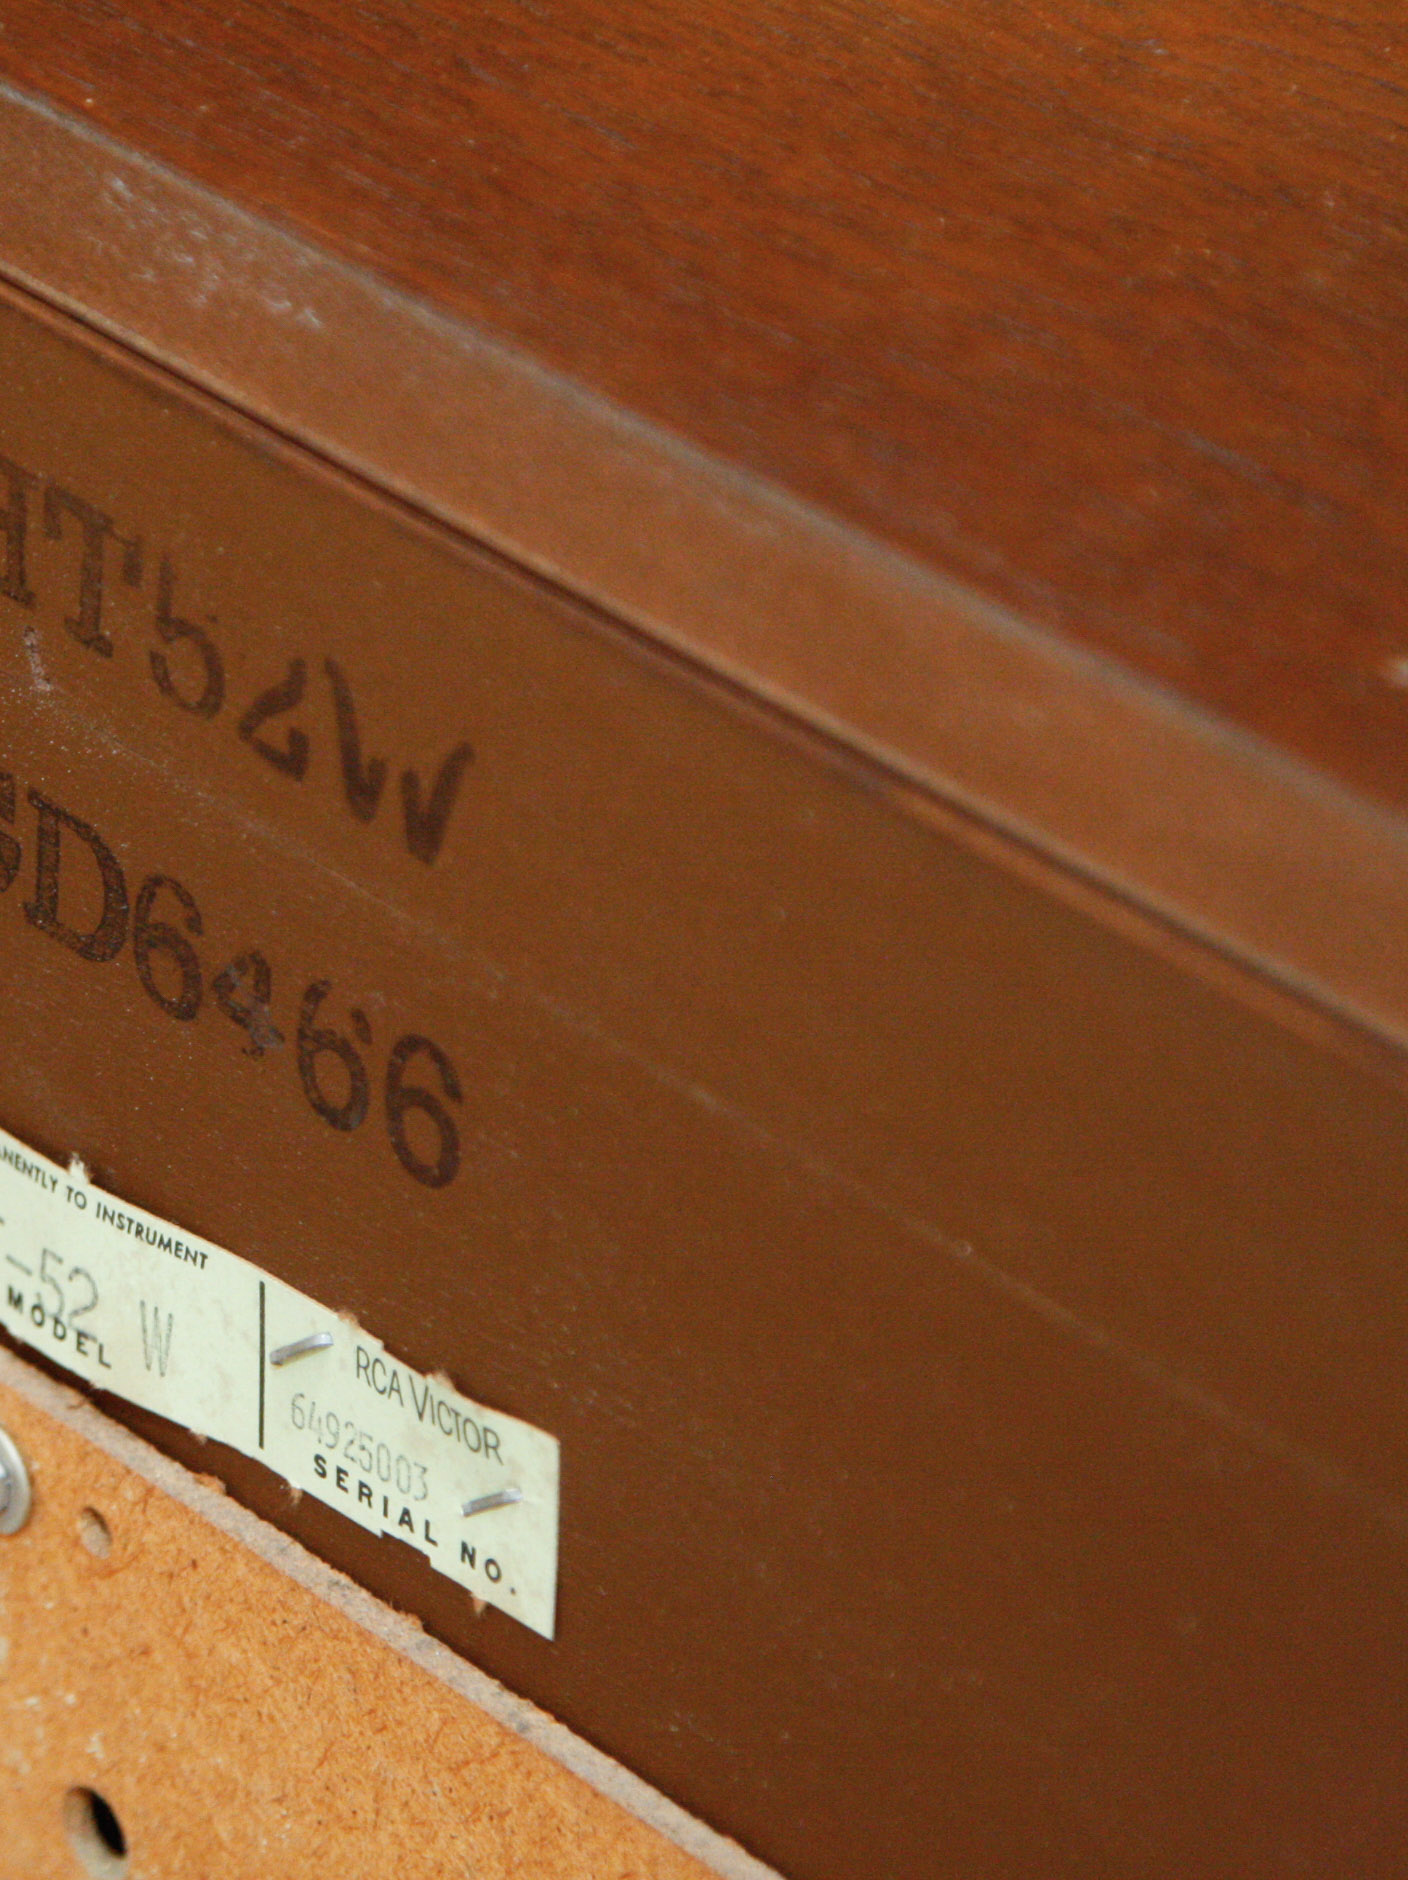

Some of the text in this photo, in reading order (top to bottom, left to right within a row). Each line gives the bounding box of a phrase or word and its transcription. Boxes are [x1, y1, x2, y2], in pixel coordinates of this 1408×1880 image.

[66, 1184, 88, 1211] TO
[95, 1201, 209, 1270] INSTRUMENT
[7, 1283, 112, 1369] MODEL
[139, 1299, 174, 1378] W
[355, 1344, 405, 1408] RCA
[290, 1392, 429, 1501] 64925003
[312, 1452, 517, 1596] SERIAL NO.
